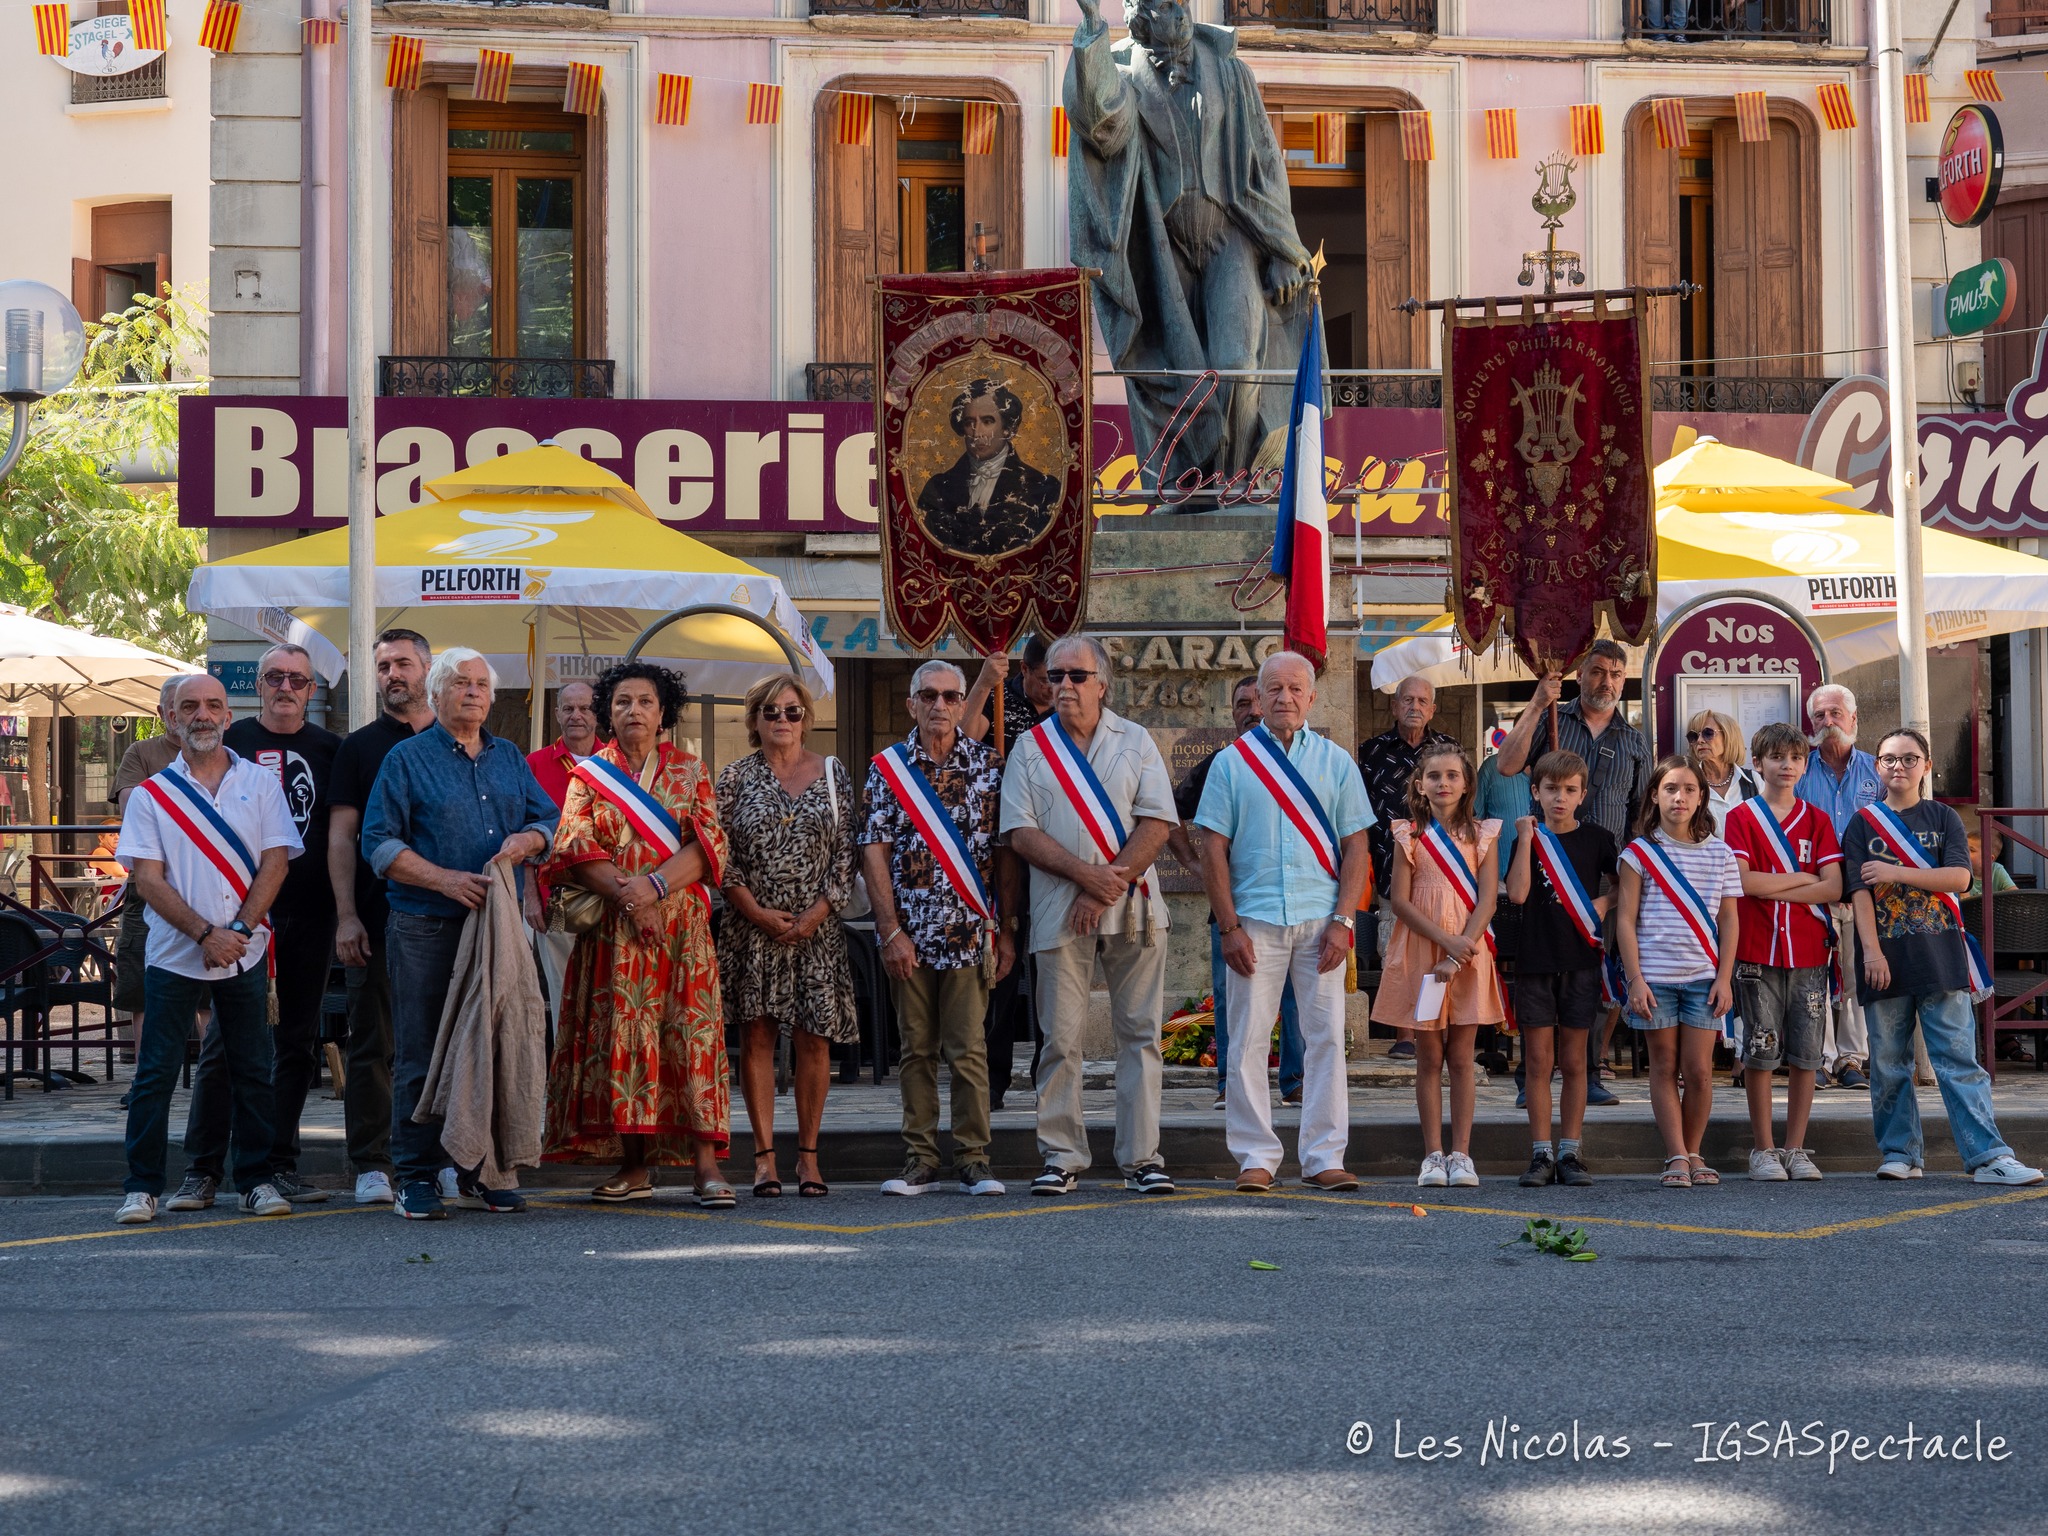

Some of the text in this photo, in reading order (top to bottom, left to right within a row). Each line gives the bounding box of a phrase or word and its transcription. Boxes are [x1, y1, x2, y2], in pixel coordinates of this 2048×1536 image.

[94, 17, 127, 29] SIEGE
[1950, 289, 1979, 319] PMU
[997, 312, 1066, 357] ARAGO
[1506, 335, 1635, 416] PHILHARMONIQUE
[1477, 530, 1626, 584] ESTAGEL
[421, 568, 520, 592] PELFORTH
[1808, 576, 1896, 601] PELFORTH
[1706, 617, 1775, 643] Nos
[1681, 650, 1800, 675] Cartes
[1120, 678, 1202, 708] 1786
